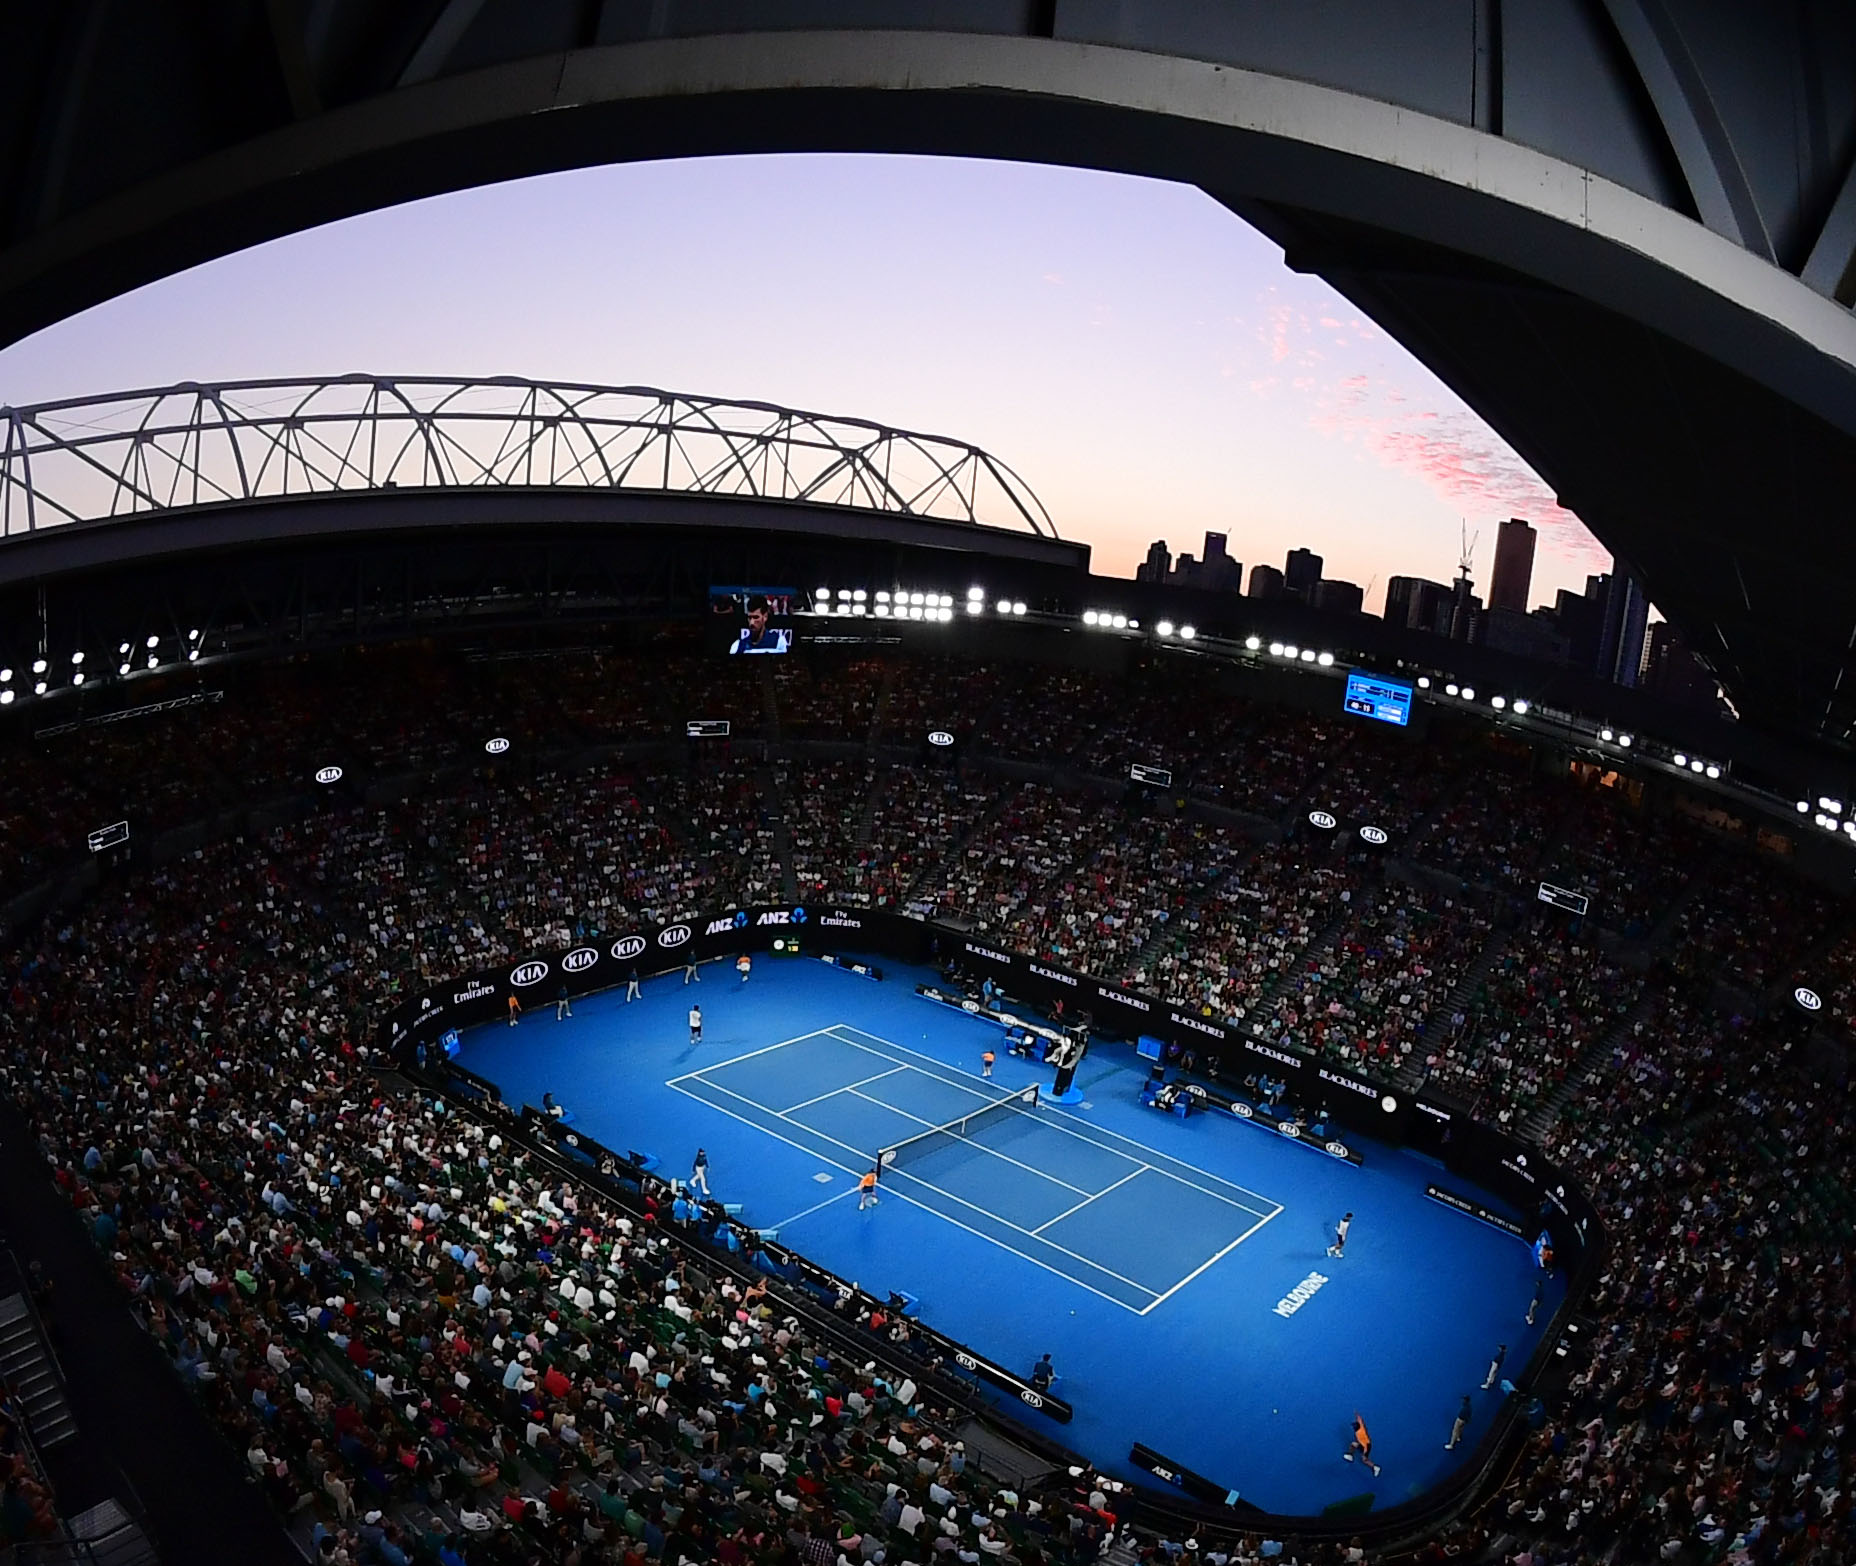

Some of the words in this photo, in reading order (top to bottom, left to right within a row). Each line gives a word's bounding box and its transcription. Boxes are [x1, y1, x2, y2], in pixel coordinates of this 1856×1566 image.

[705, 917, 734, 936] ANZ
[756, 911, 790, 926] ANZ
[820, 916, 862, 929] Emirates
[965, 942, 1011, 964] BLACKMORES
[1029, 963, 1078, 987] BLACKMORES
[453, 984, 495, 1005] Emirates
[1098, 987, 1150, 1012] BLACKMORES
[1171, 1013, 1225, 1039] BLACKMORES
[1245, 1039, 1302, 1069] BLACKMORES
[1319, 1068, 1378, 1099] BLACKMORES
[1271, 1270, 1329, 1319] MELBOURNE
